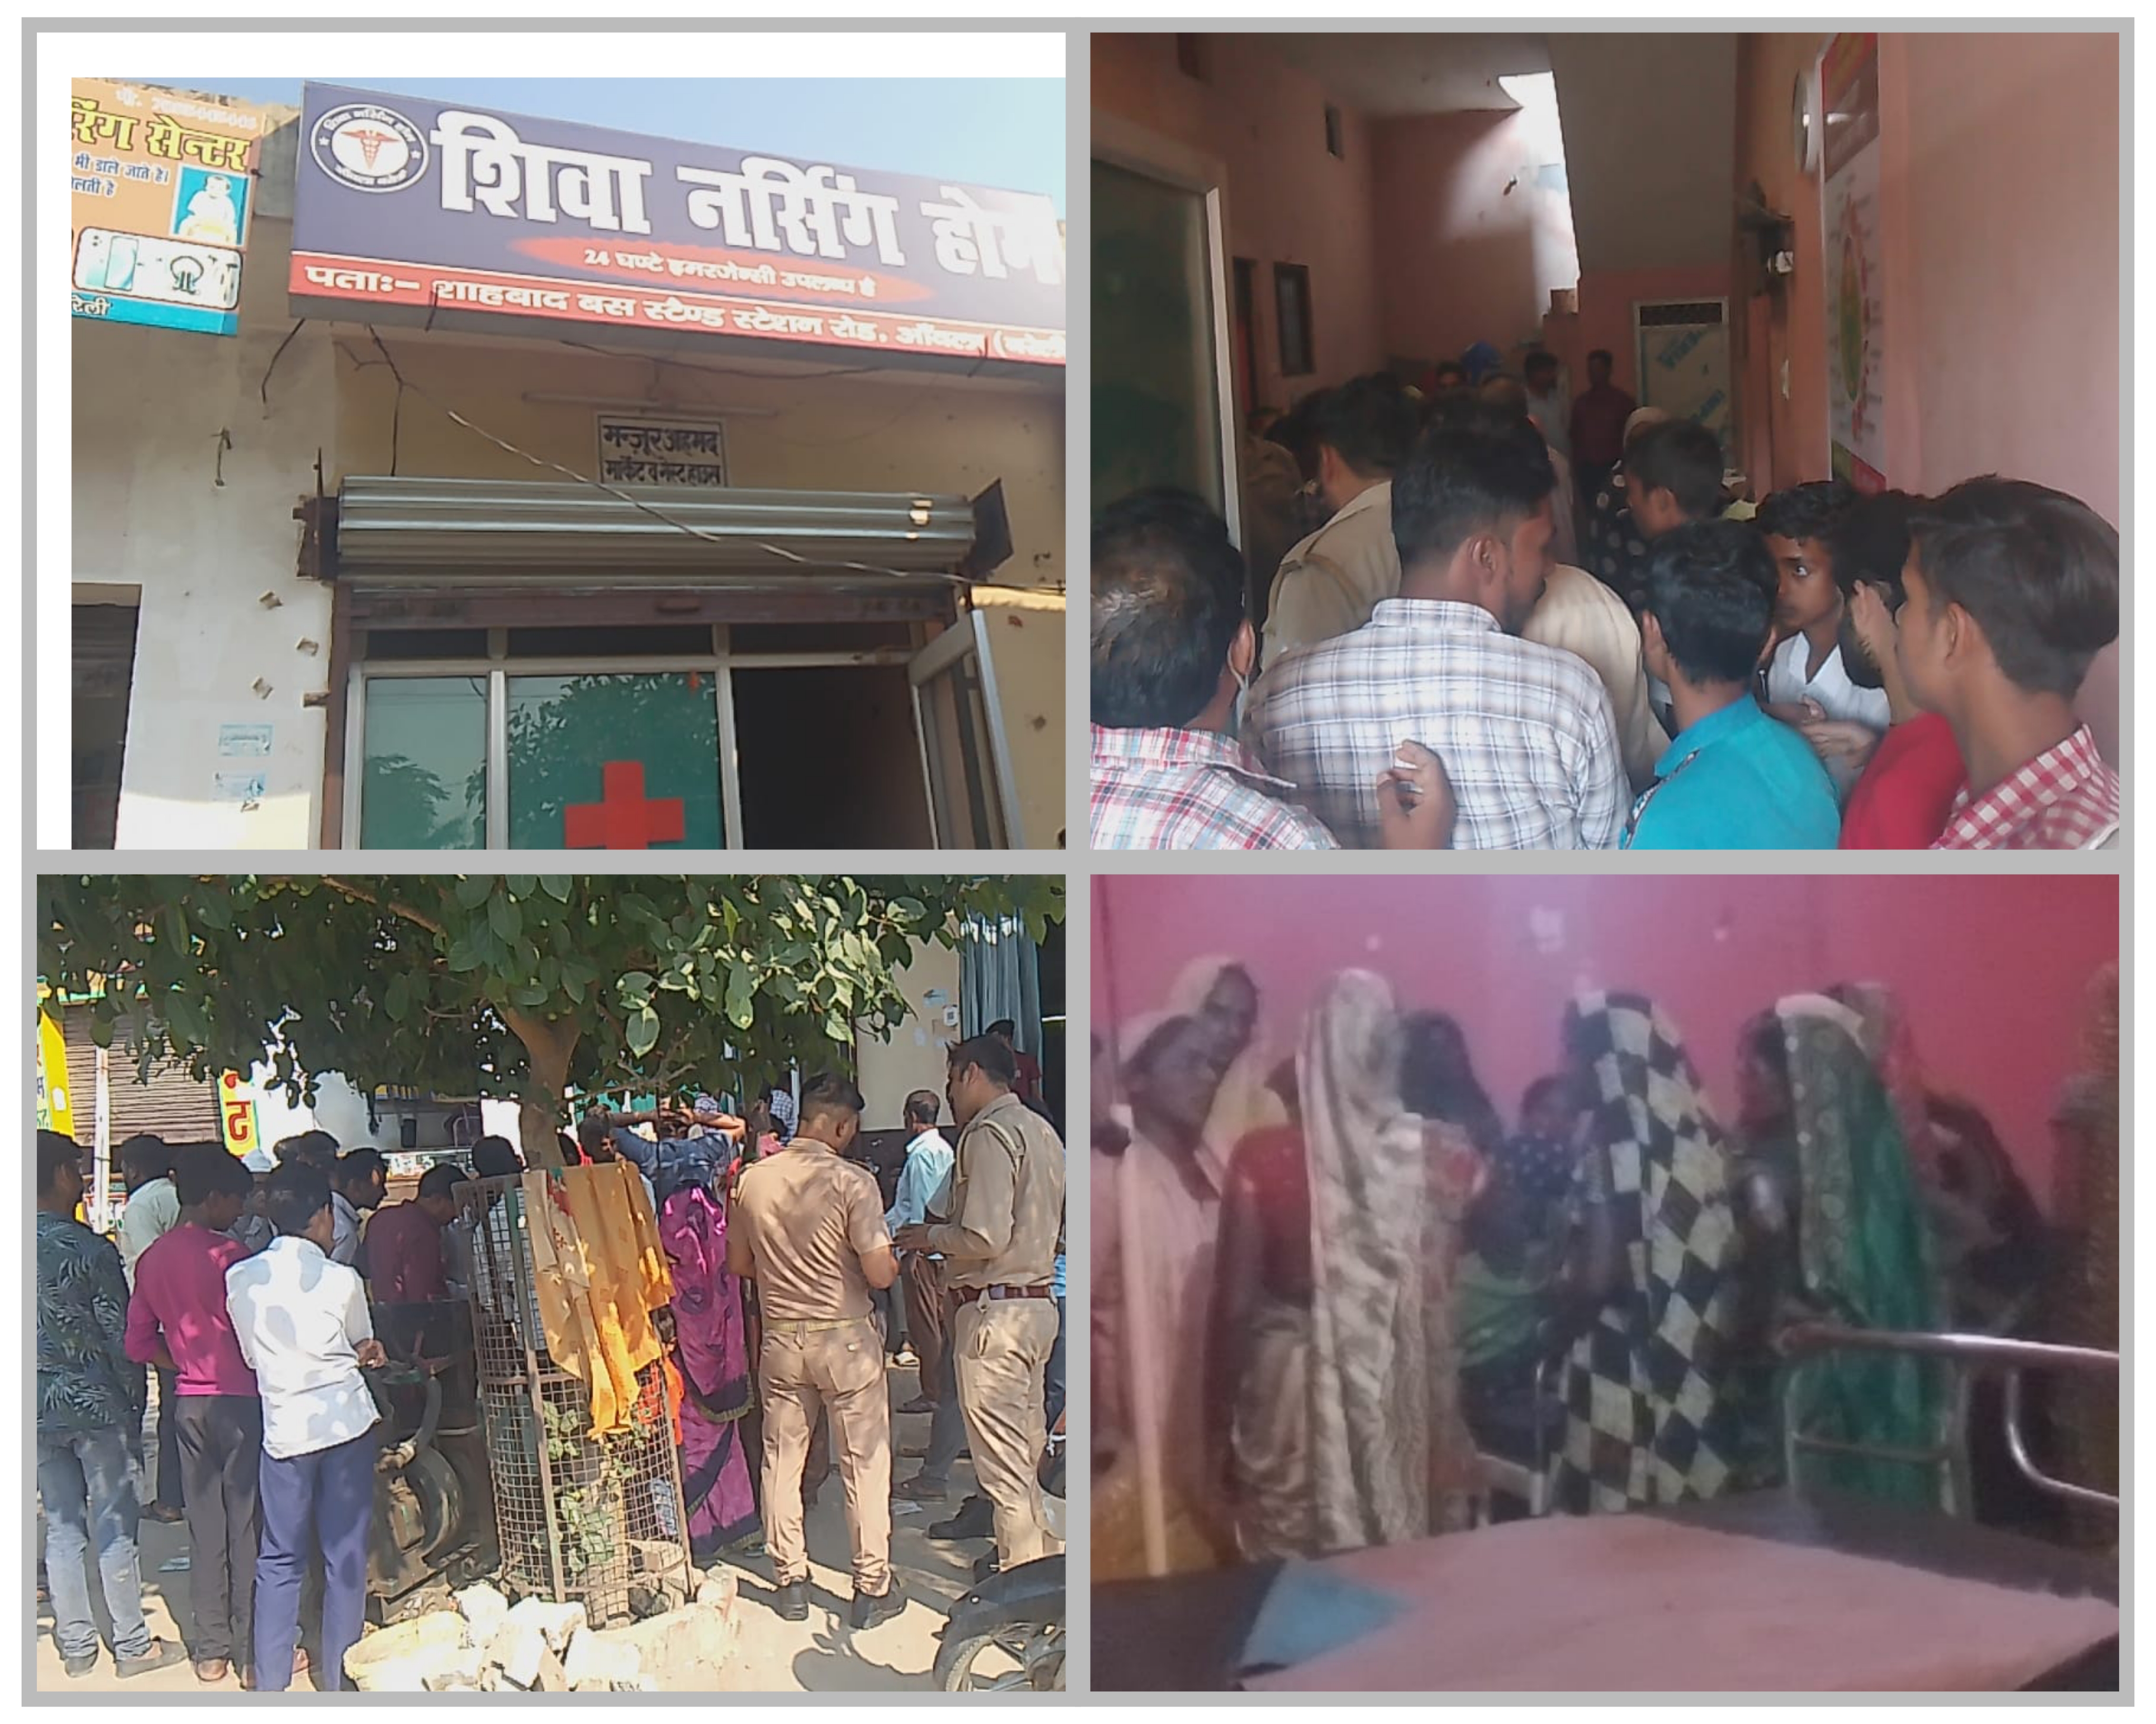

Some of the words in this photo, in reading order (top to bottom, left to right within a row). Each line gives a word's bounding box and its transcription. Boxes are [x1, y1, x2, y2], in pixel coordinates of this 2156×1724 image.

[146, 112, 253, 172] सेन्टर
[430, 109, 653, 235] शिवा
[676, 155, 905, 267] नर्सिंग
[584, 248, 610, 266] 24
[432, 280, 571, 310] शाहबाद
[577, 293, 636, 316] बस
[731, 305, 823, 336] स्टेशन
